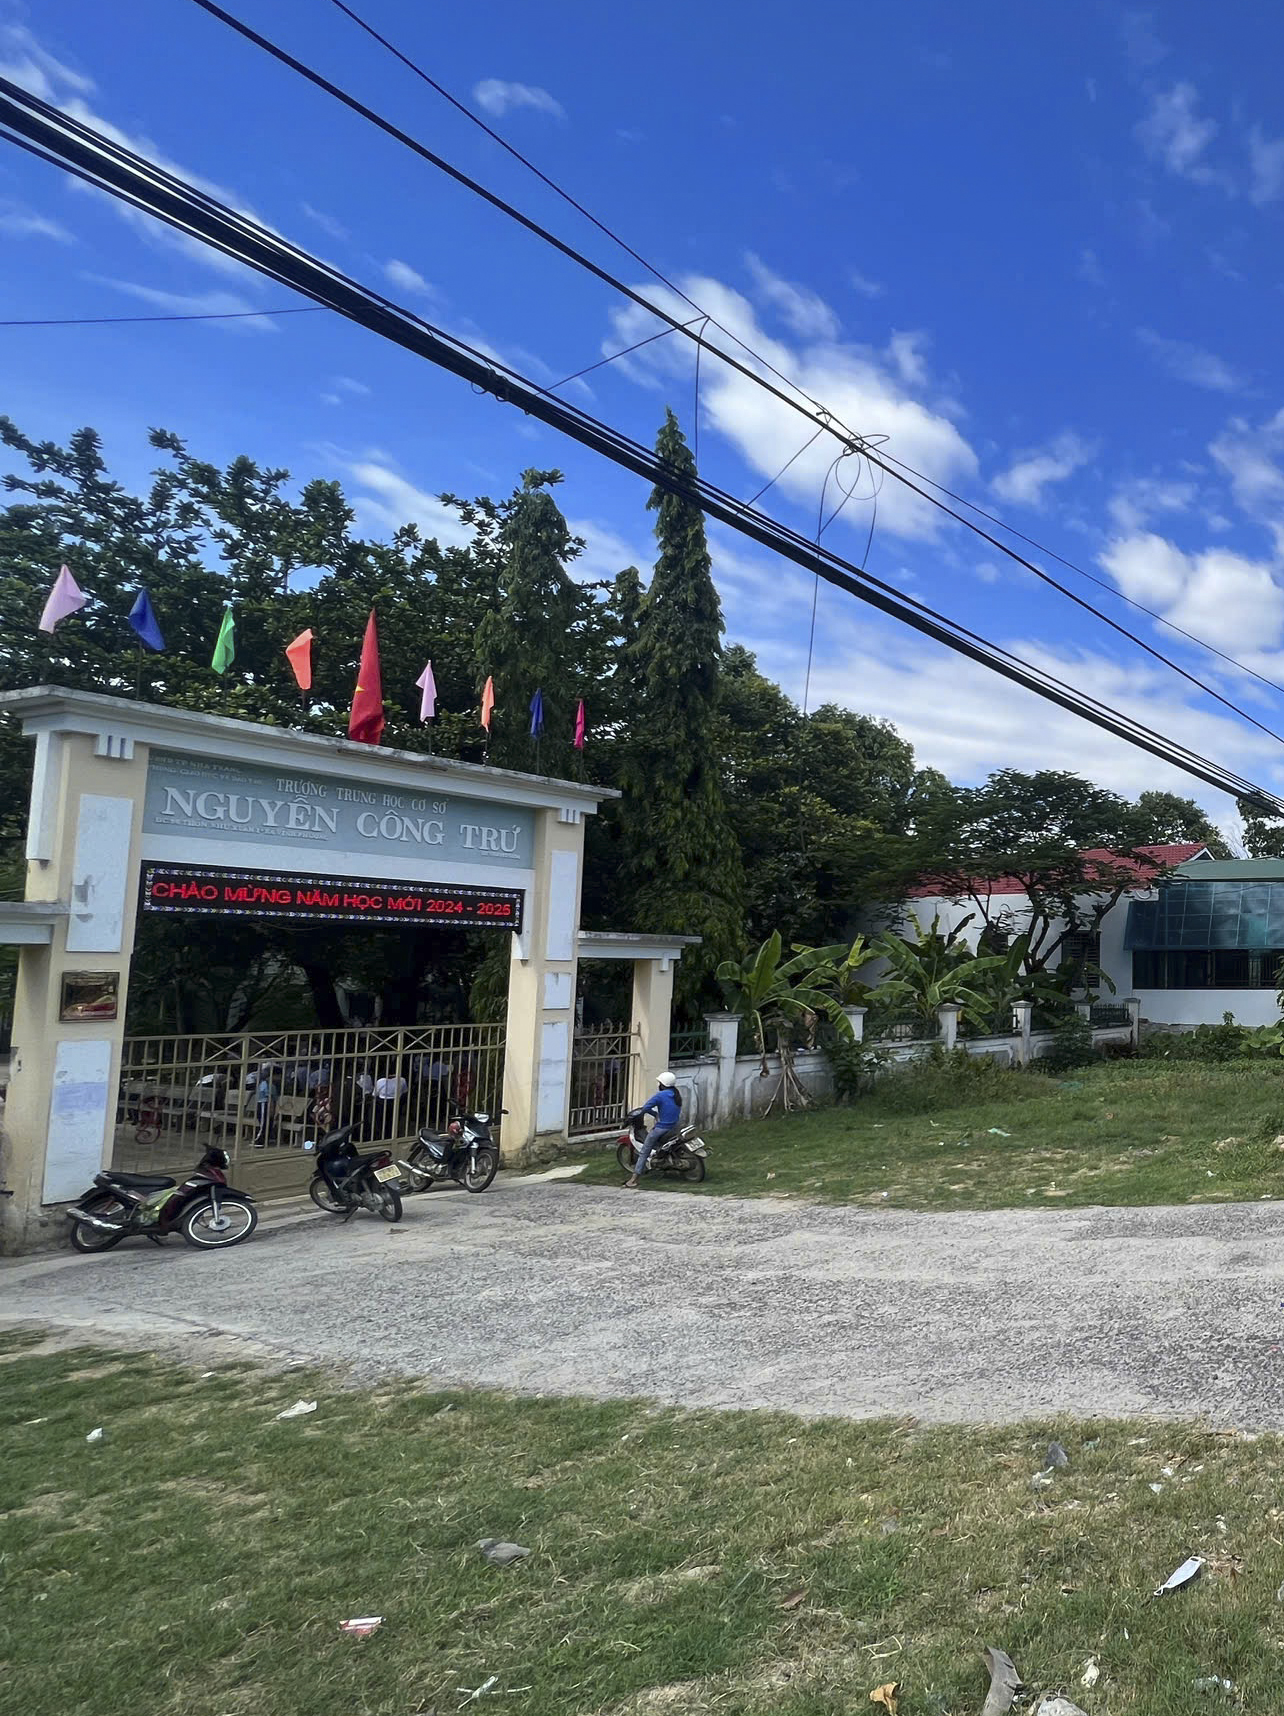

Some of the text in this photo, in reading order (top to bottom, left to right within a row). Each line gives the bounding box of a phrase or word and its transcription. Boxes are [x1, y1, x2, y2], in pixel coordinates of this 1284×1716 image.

[336, 787, 377, 804] TRUNG
[161, 786, 522, 853] NGUYỄN CÔNG TRỨ
[151, 880, 219, 900] CHÀO
[223, 884, 292, 904] MỪNG
[296, 889, 340, 907] NĂM
[343, 893, 383, 911] HỌC
[387, 895, 422, 911] MỚI
[426, 899, 463, 914] 2024
